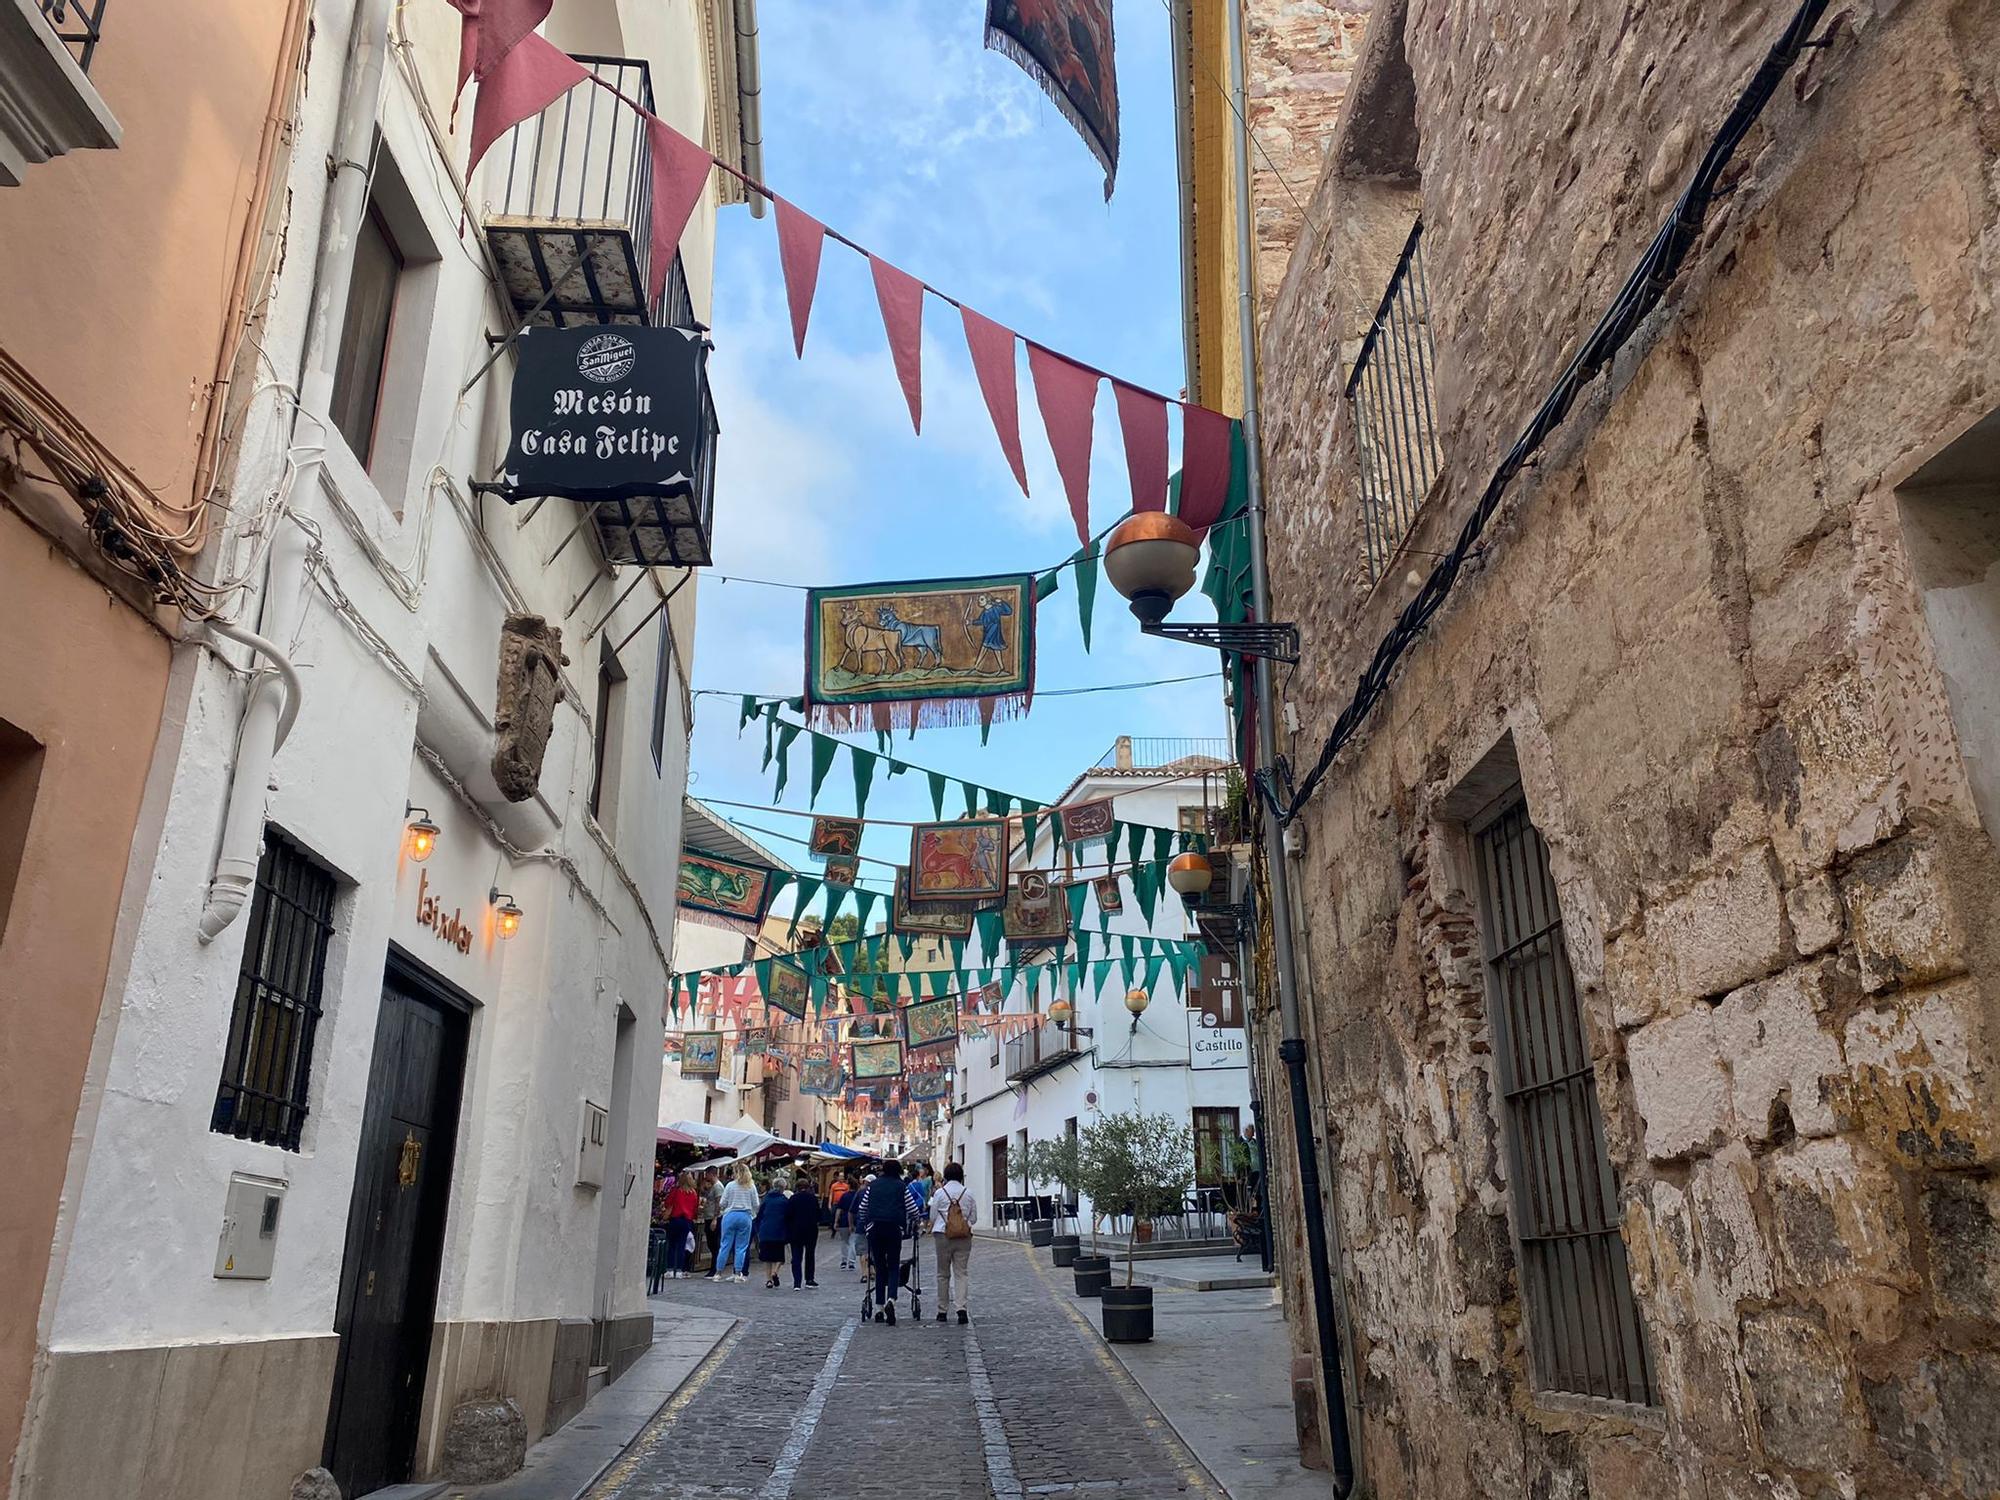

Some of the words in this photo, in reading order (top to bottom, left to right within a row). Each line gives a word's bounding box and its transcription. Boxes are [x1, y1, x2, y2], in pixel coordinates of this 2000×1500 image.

[553, 388, 652, 416] Mesón
[520, 429, 588, 456] Casa
[595, 425, 680, 463] Felipe
[1213, 1028, 1223, 1038] el
[1195, 1039, 1243, 1052] Castillo
